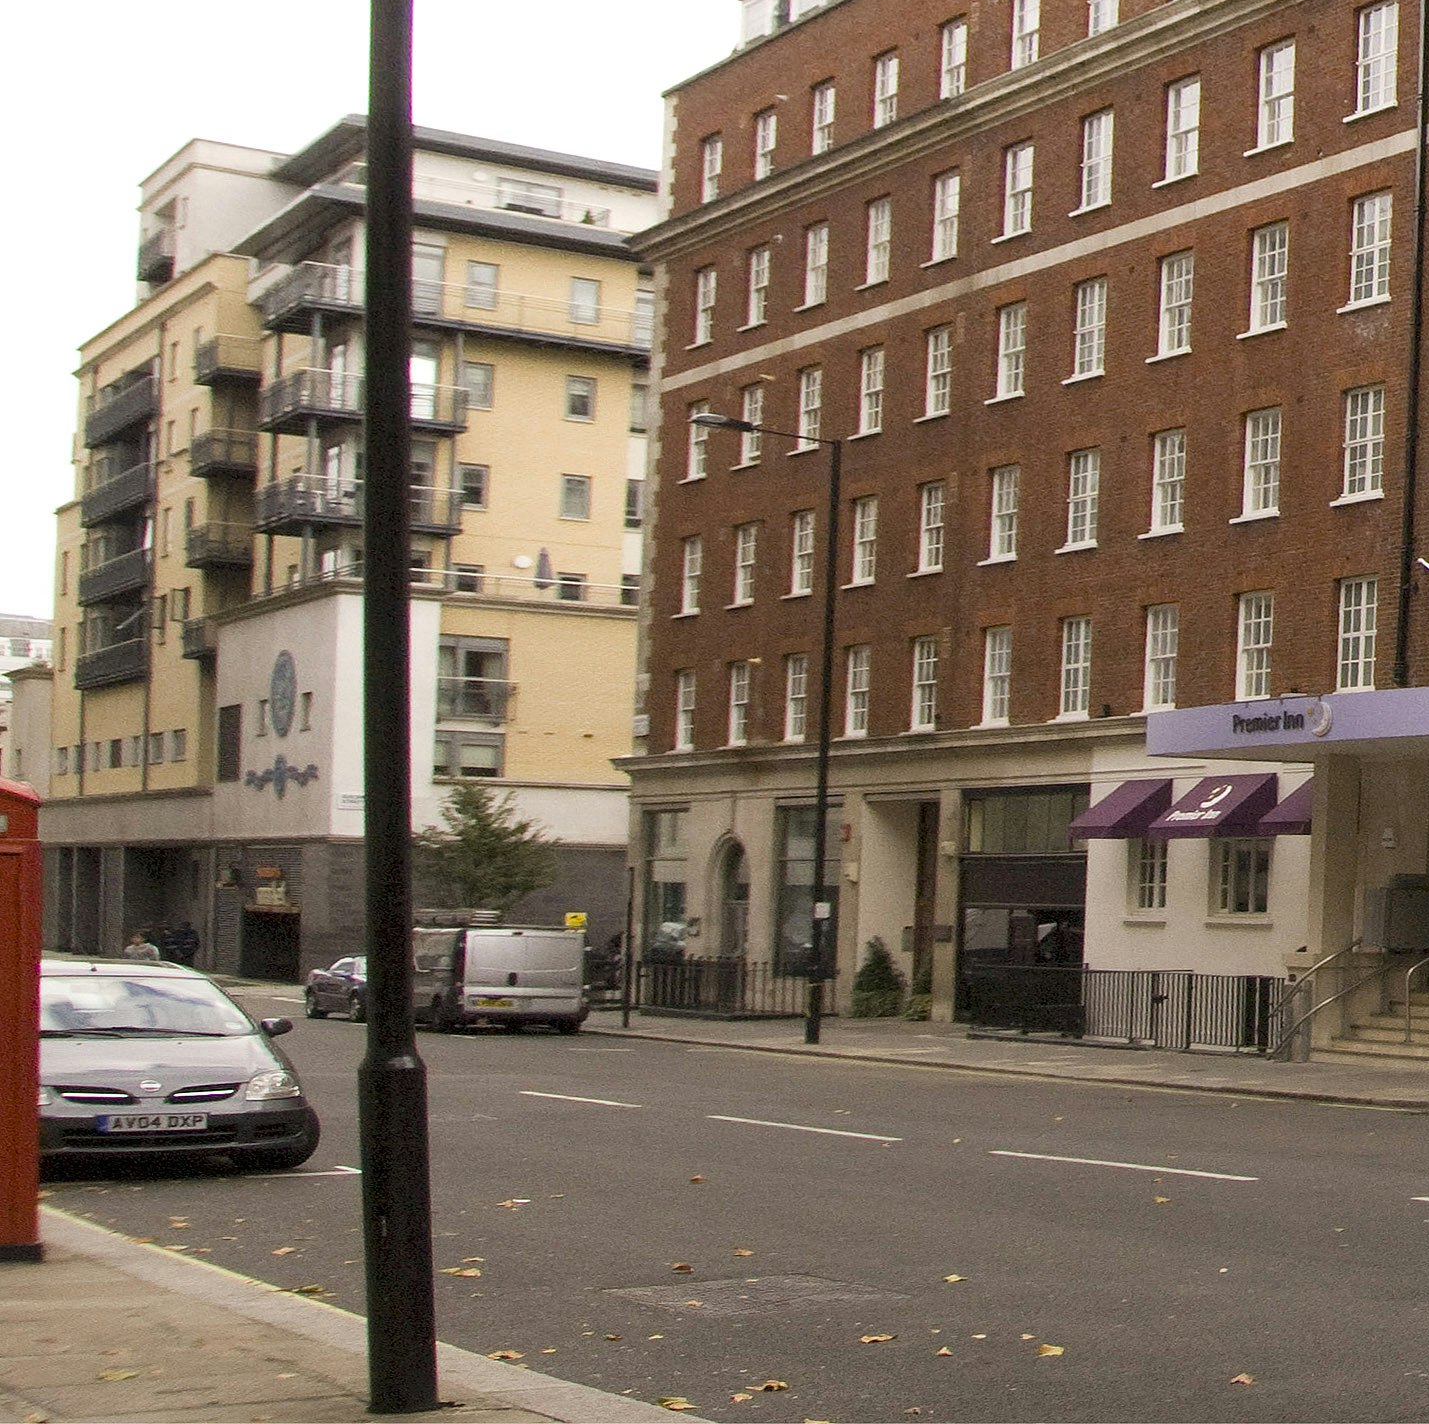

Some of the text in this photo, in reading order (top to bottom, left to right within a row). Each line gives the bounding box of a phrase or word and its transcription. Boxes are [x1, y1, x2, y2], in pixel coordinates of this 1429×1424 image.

[1232, 711, 1304, 734] Premier Inn
[1165, 809, 1222, 822] Premier Inn
[112, 1115, 204, 1129] AV04 DXP
